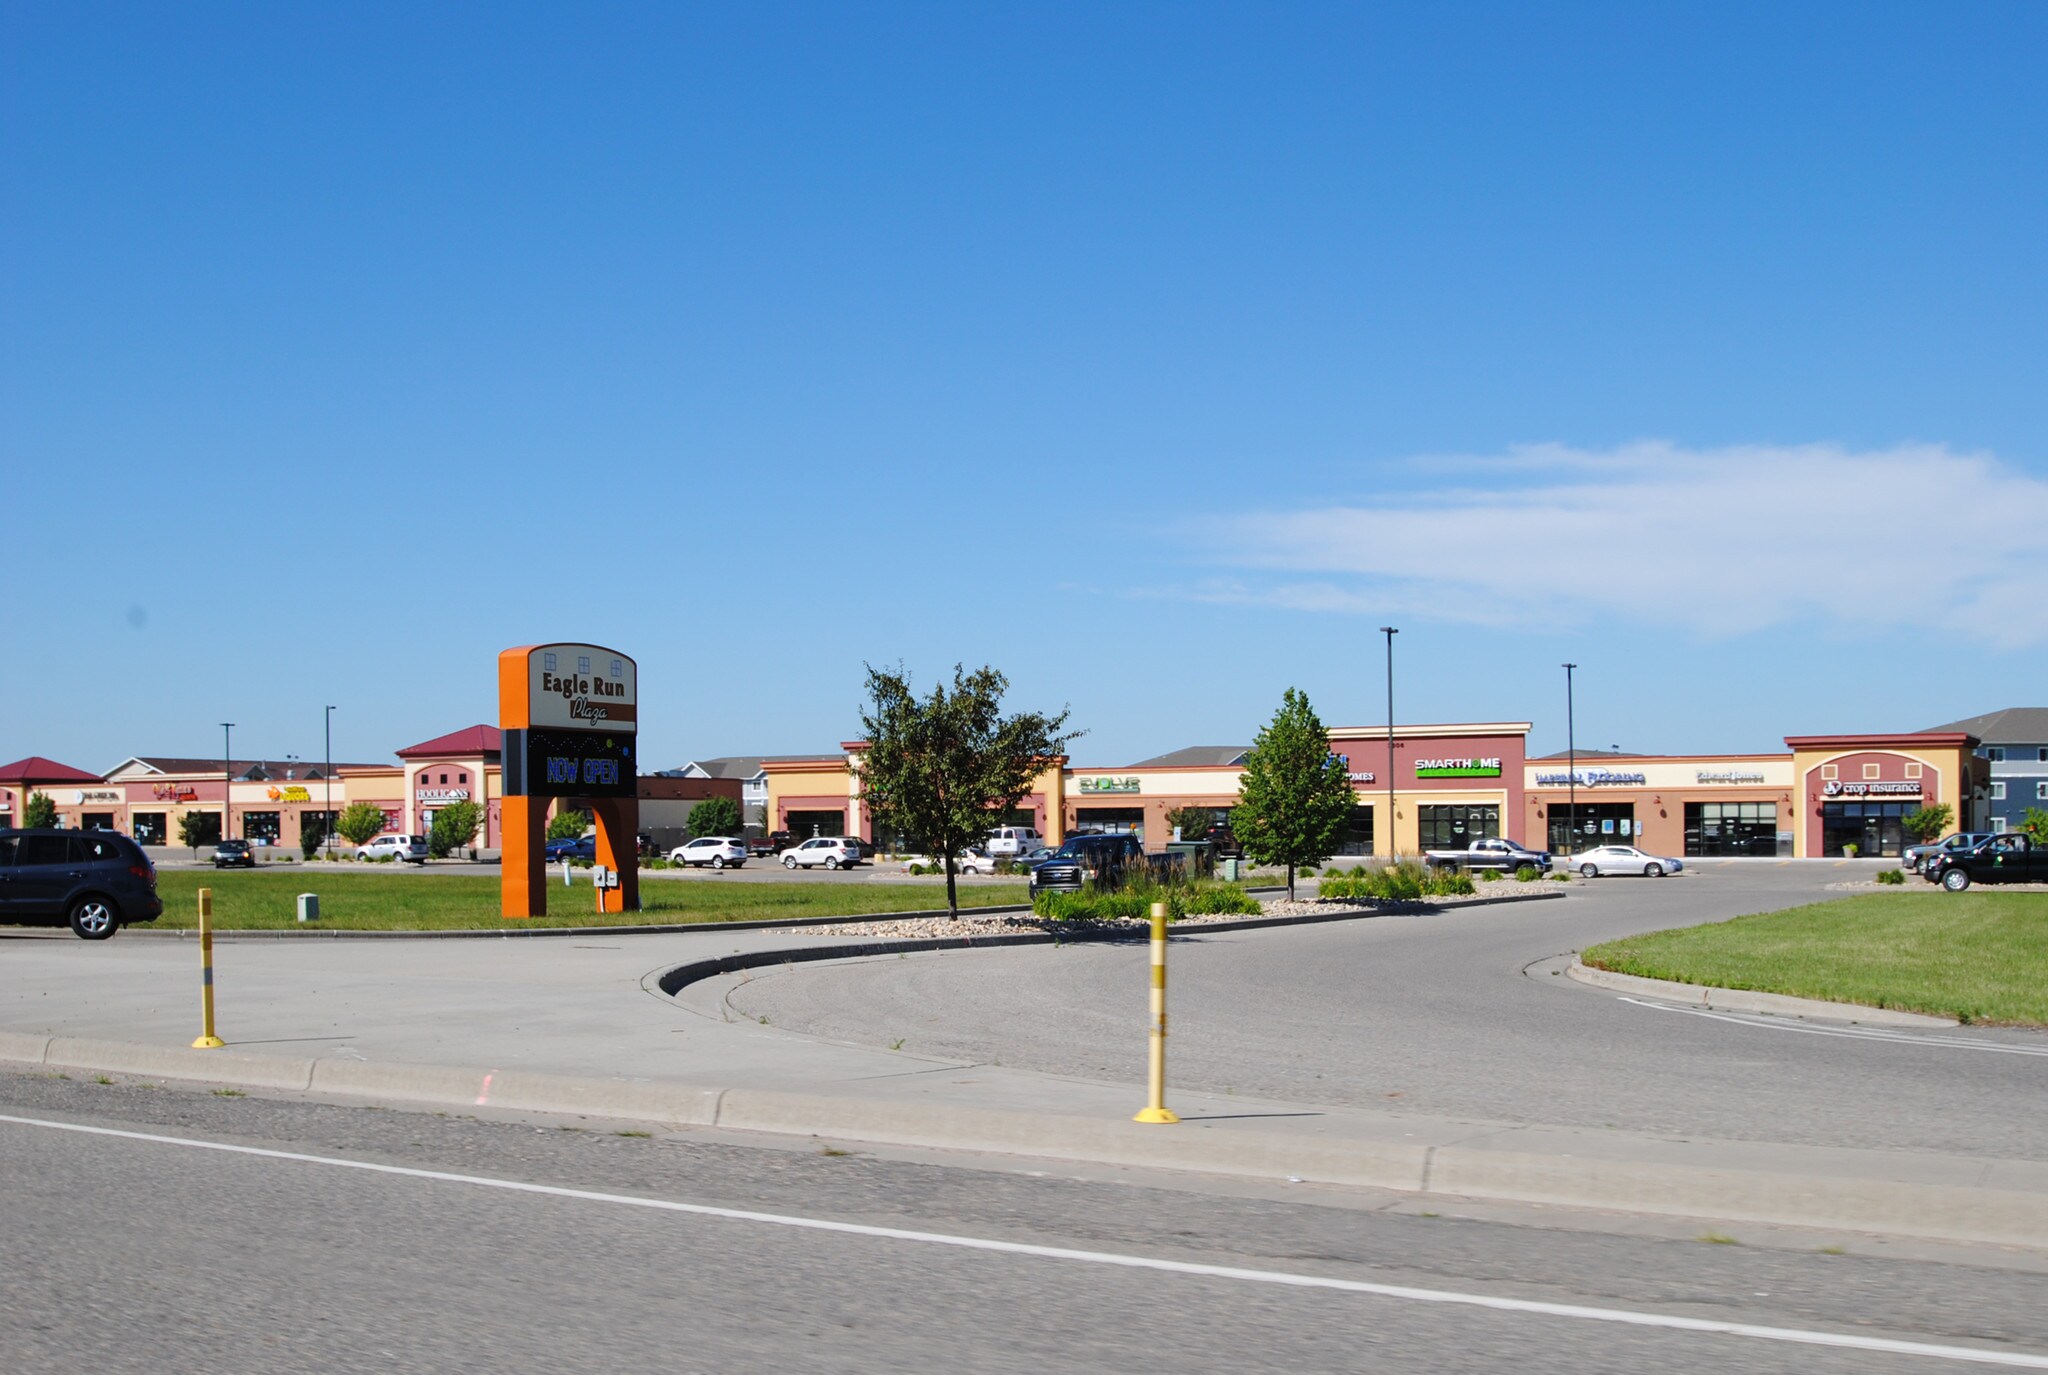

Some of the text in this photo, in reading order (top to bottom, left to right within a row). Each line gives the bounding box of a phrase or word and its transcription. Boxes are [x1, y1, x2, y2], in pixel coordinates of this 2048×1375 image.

[543, 672, 625, 699] Eagle Run
[570, 696, 608, 726] Plaza
[547, 756, 619, 785] NOW OPEN
[1414, 757, 1501, 769] SMARTHOME
[1843, 784, 1867, 795] crop
[1869, 783, 1920, 793] insurance
